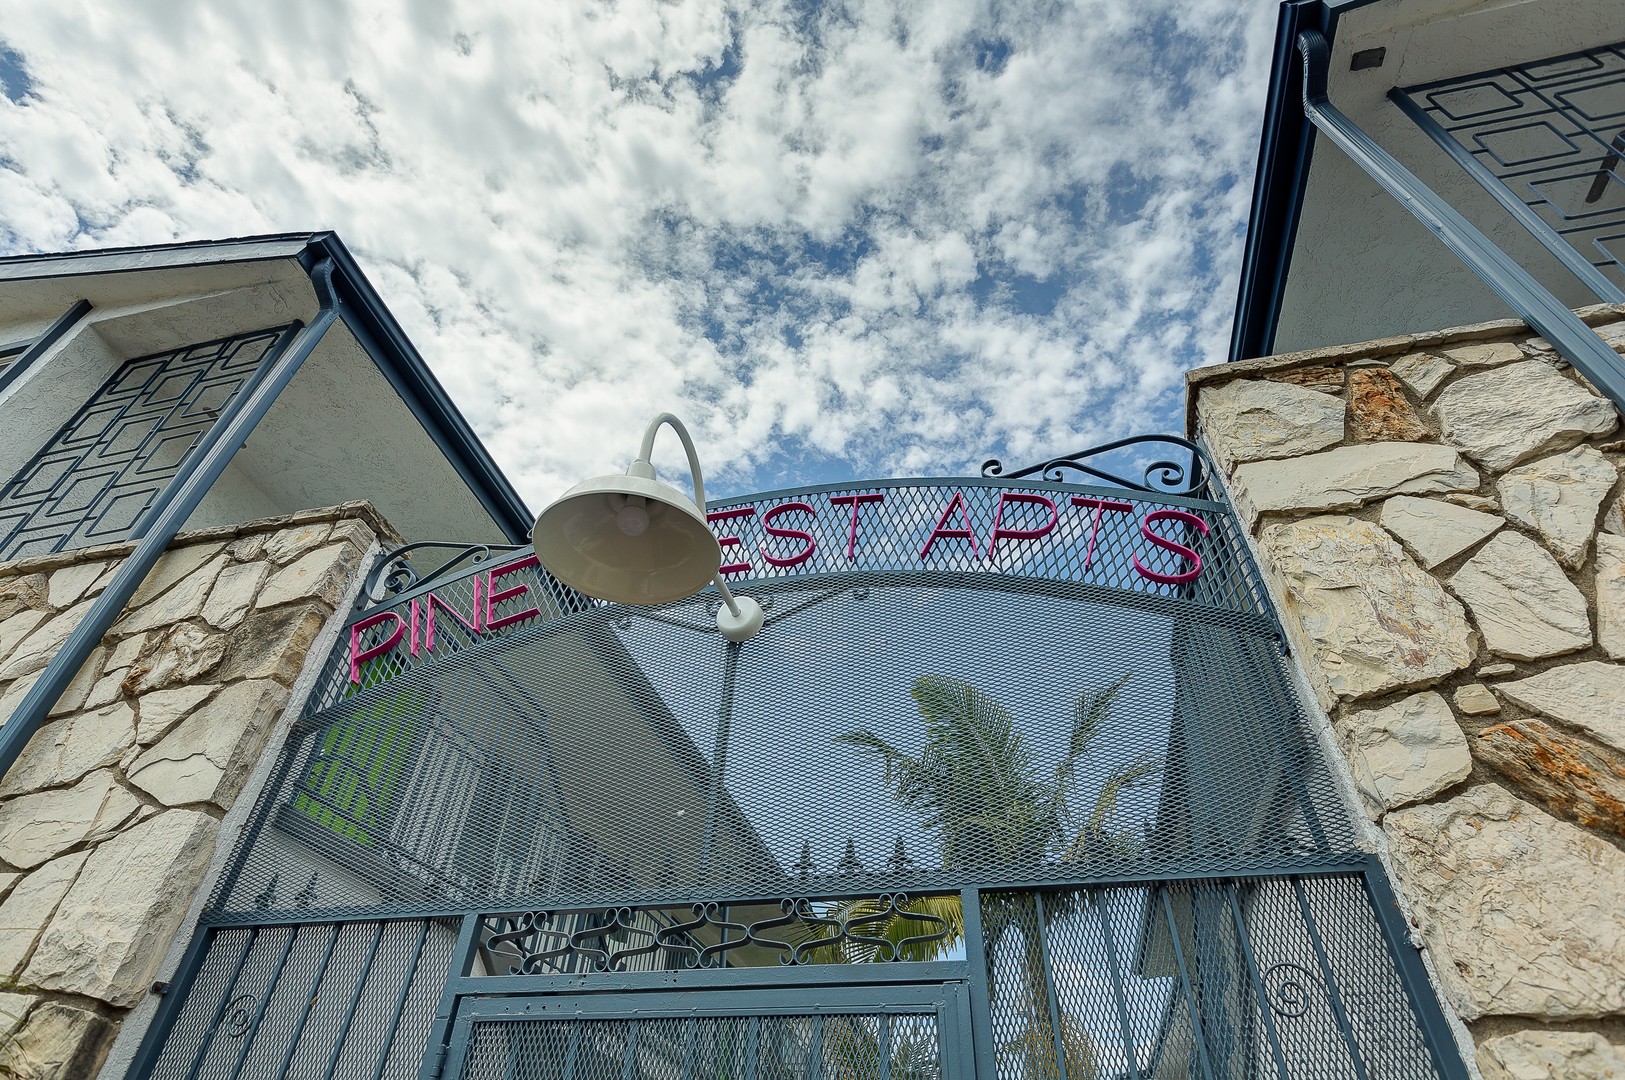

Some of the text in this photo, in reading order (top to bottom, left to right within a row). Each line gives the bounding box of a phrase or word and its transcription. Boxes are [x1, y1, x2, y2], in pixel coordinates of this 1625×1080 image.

[351, 492, 1209, 684] PINE EST APTS
